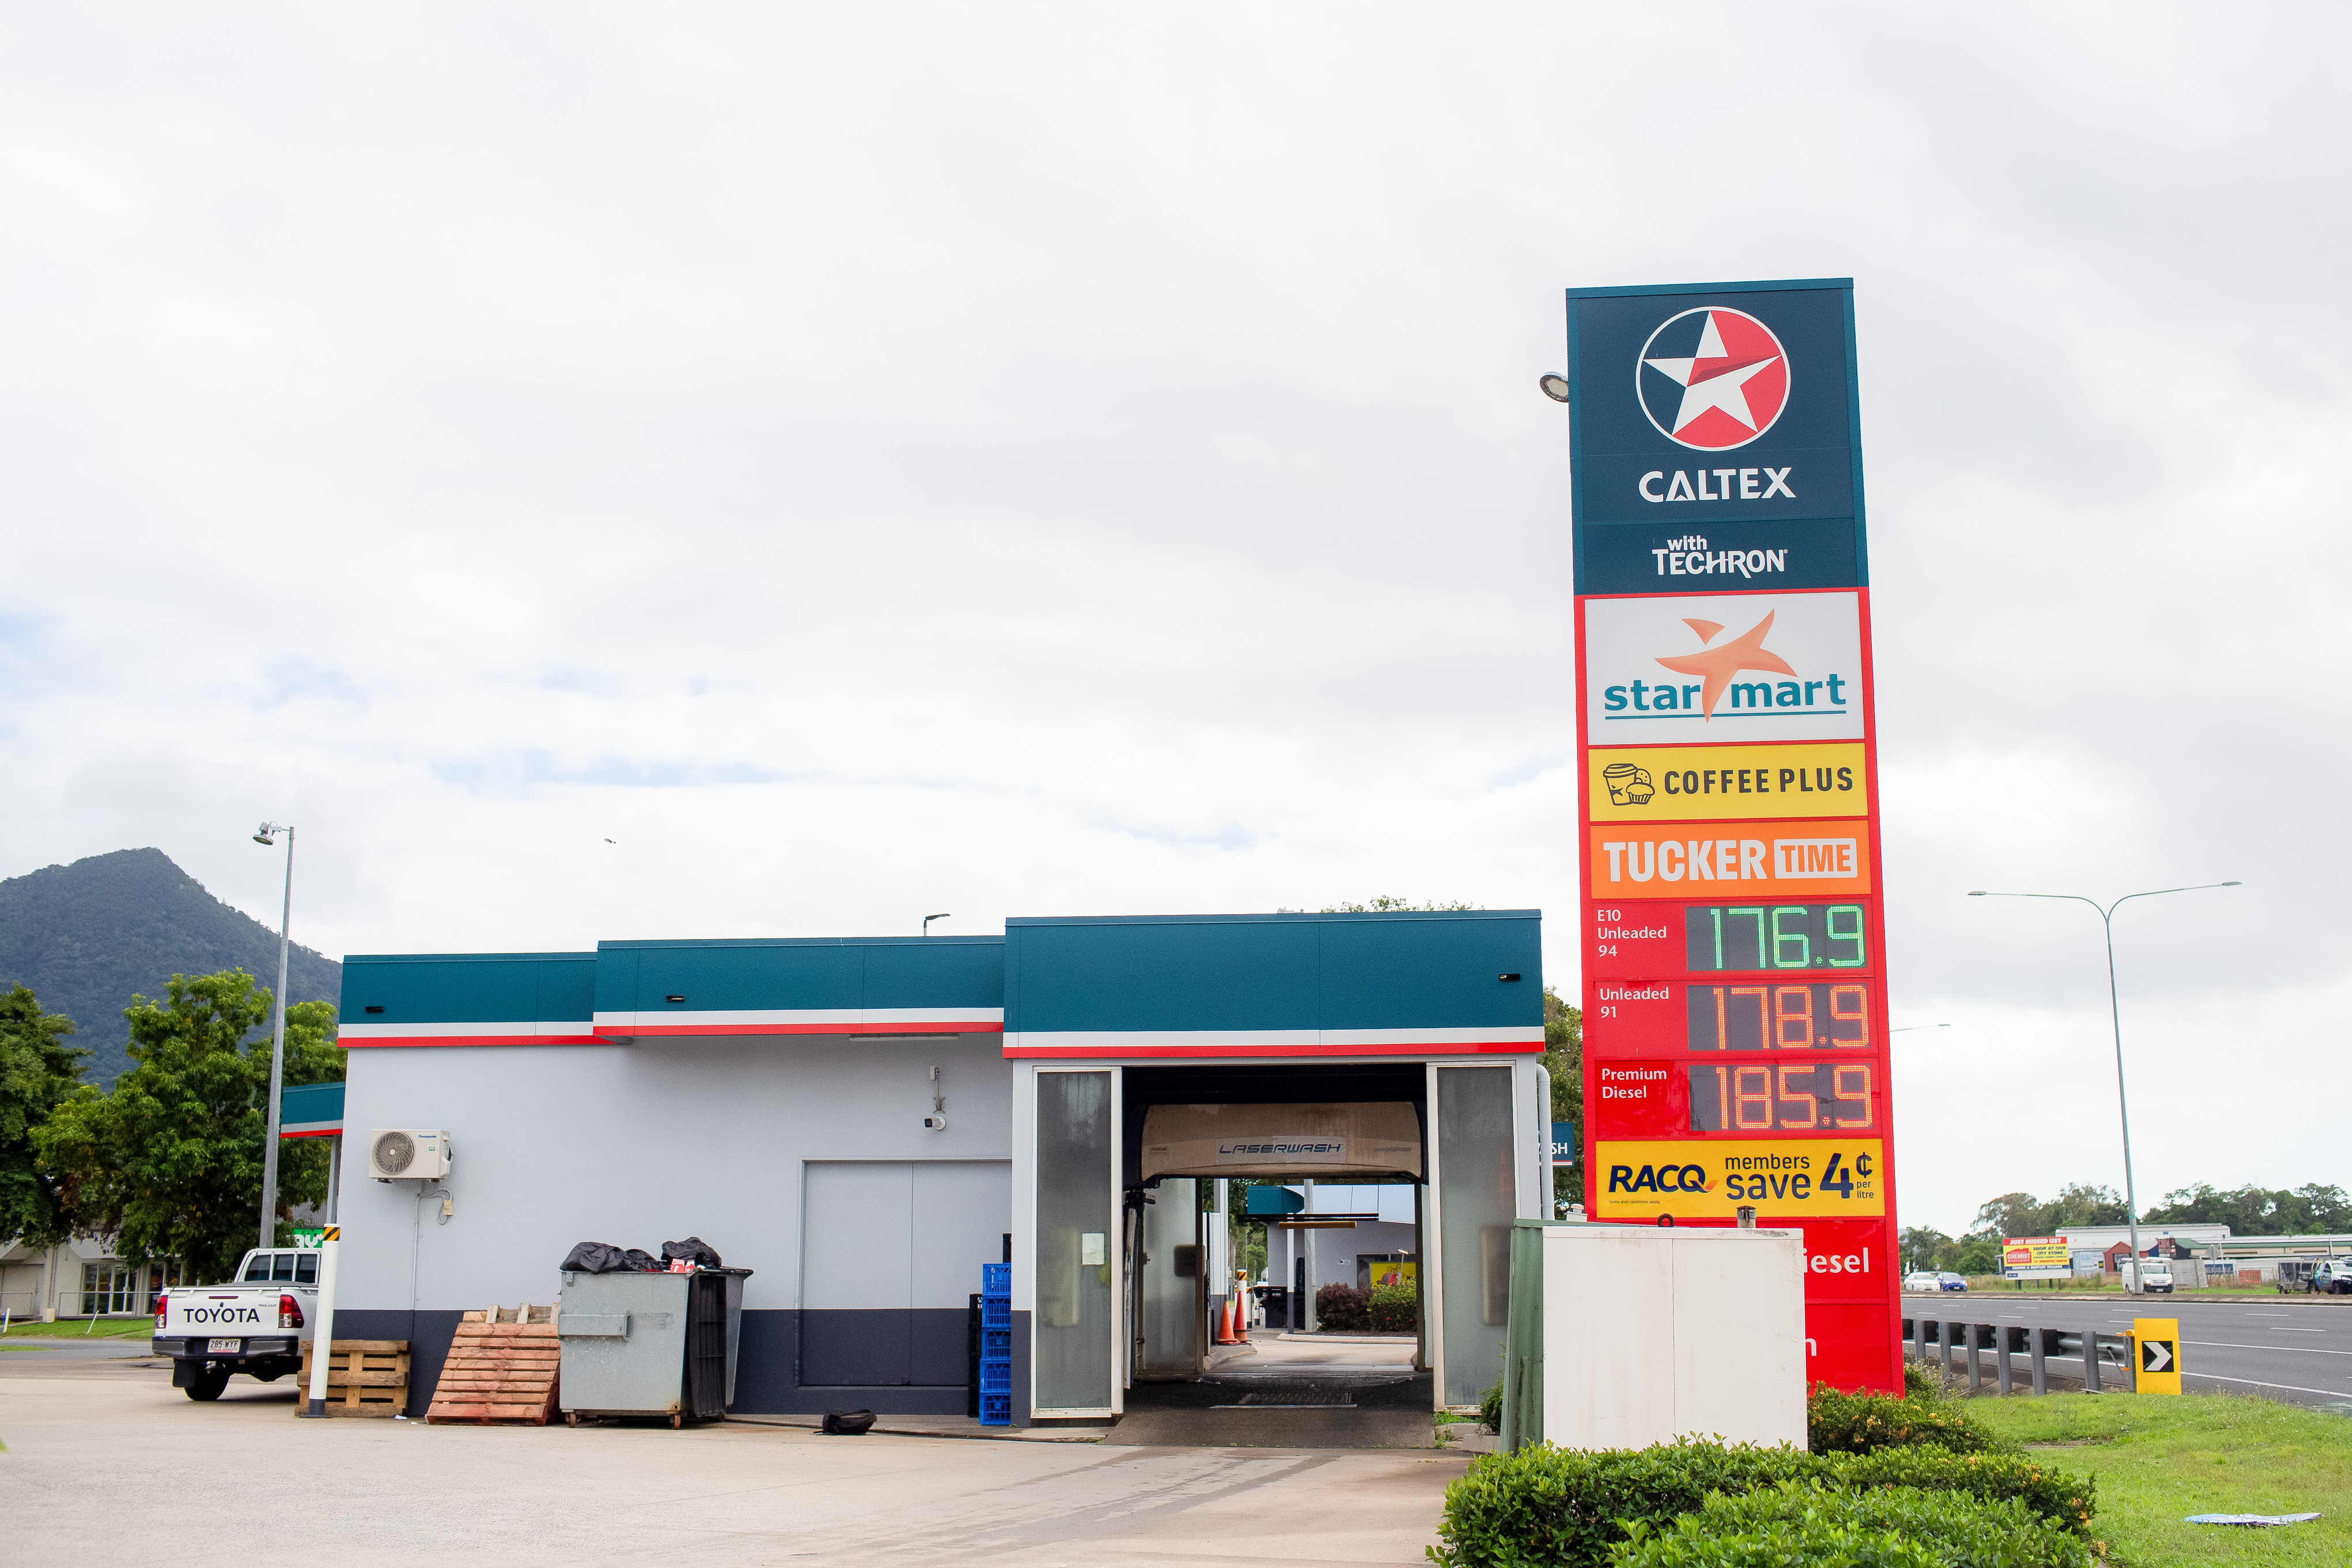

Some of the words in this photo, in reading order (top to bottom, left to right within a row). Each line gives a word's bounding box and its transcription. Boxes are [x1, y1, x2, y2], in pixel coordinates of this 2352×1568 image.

[1638, 467, 1796, 503] CALTEX
[1667, 535, 1708, 551] with
[1604, 679, 1701, 711] star
[1731, 673, 1846, 708] mart
[1664, 769, 1770, 795] COFFEE
[1780, 767, 1853, 793] PLUS
[1603, 839, 1767, 882] TUCKER
[1780, 843, 1852, 873] TIME
[1597, 909, 1621, 922] E10
[1597, 926, 1667, 940] Unleaded
[1710, 905, 1866, 969] 176.9
[1598, 945, 1618, 958] 94
[1600, 987, 1669, 1001] Unleaded
[1600, 1006, 1617, 1019] 91
[1713, 985, 1869, 1050] 178.9
[1601, 1068, 1667, 1081] Premium
[1602, 1085, 1647, 1099] Diesel
[1716, 1065, 1873, 1130] 185.9
[1219, 1143, 1341, 1154] LASERWASH
[1725, 1154, 1810, 1170] members
[1608, 1164, 1714, 1193] RACQ
[1726, 1173, 1811, 1200] save
[1856, 1181, 1871, 1190] per
[1857, 1190, 1874, 1199] litre
[1803, 1247, 1869, 1273] iesel
[183, 1308, 260, 1324] TOYOTA
